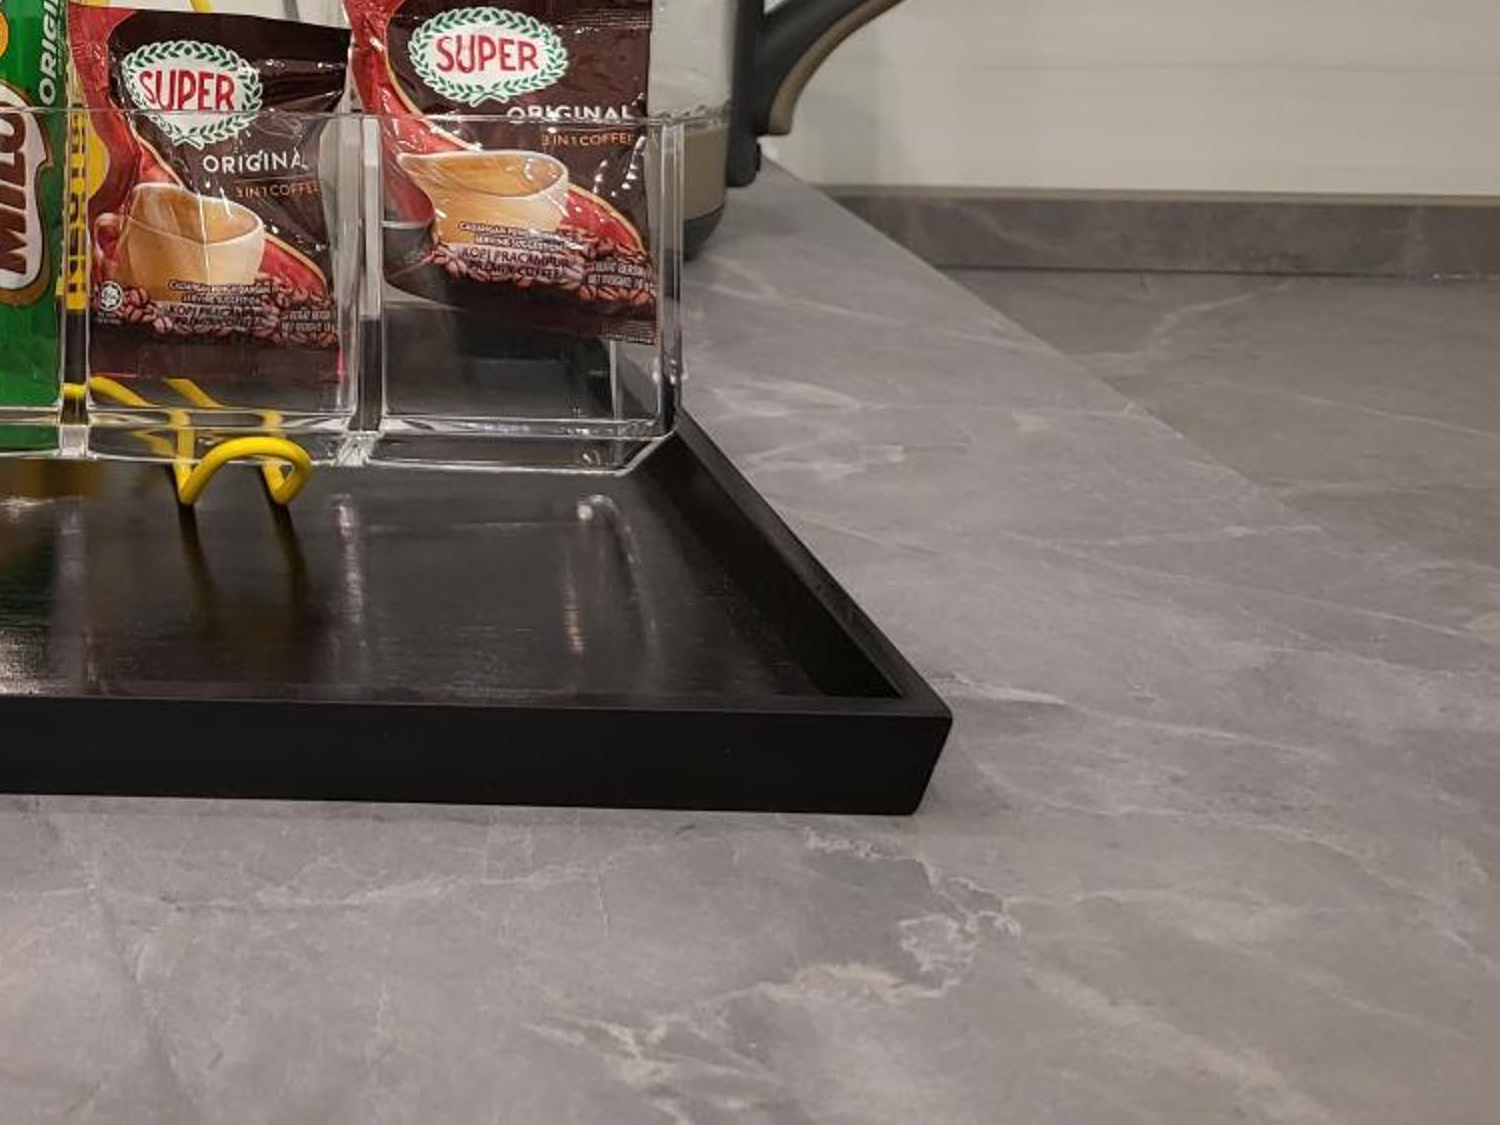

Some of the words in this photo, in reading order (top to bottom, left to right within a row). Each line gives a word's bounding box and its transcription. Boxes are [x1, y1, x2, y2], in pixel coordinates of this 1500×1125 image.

[436, 34, 539, 74] SUPER
[138, 69, 236, 115] SUPER
[507, 105, 636, 123] ORIGINAL
